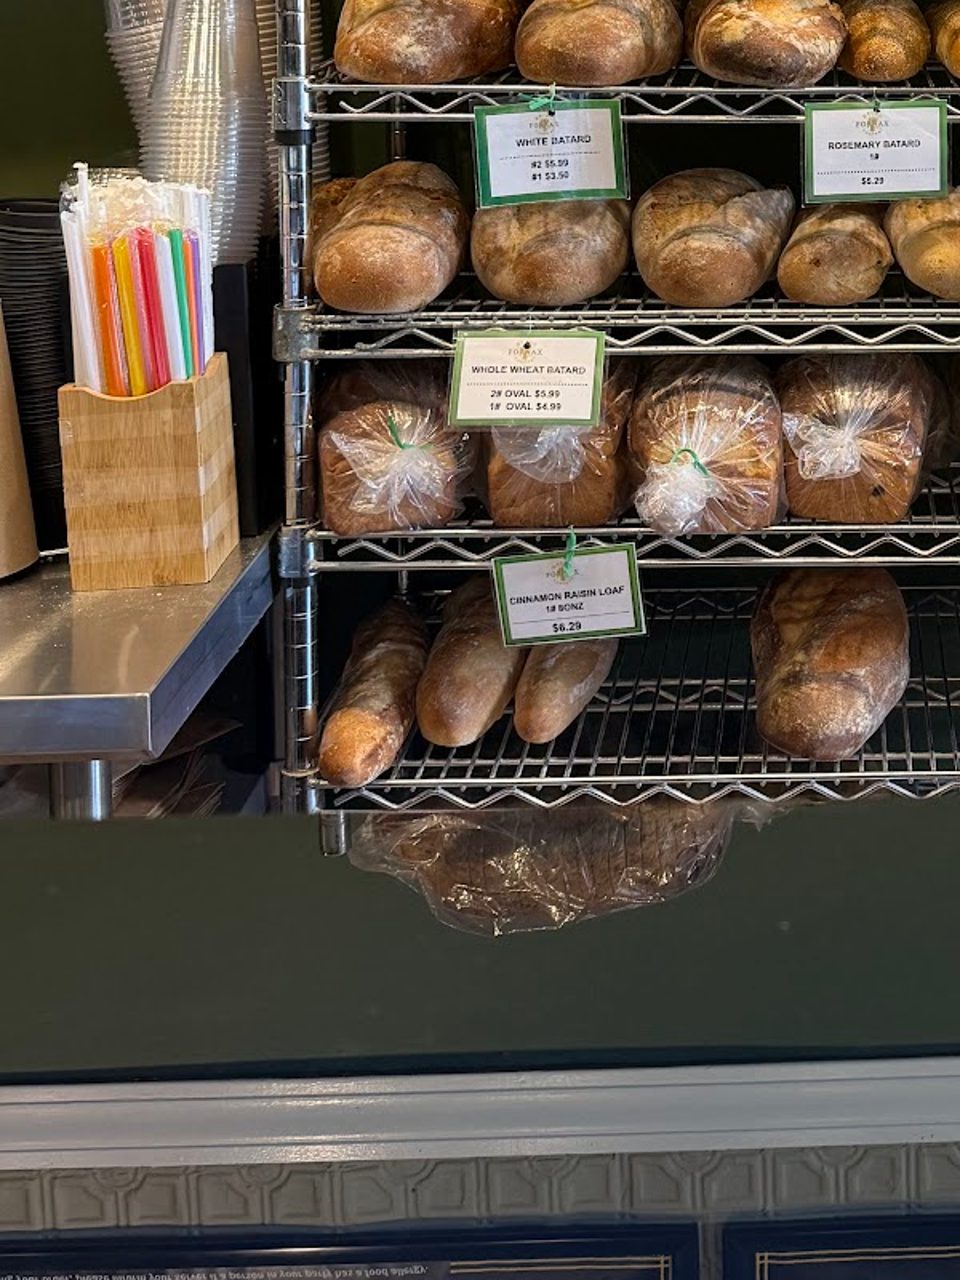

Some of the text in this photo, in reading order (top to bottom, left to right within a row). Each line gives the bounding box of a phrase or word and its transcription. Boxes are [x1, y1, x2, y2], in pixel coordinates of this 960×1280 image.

[515, 134, 592, 147] WHITE BATARD
[828, 138, 921, 150] ROSEMARY BATARD
[472, 366, 587, 375] WHOLE WHEAT BATARD
[504, 390, 532, 398] OVAL
[506, 402, 532, 410] OVAL
[509, 585, 625, 606] CINNAMON RAISIN LOAF
